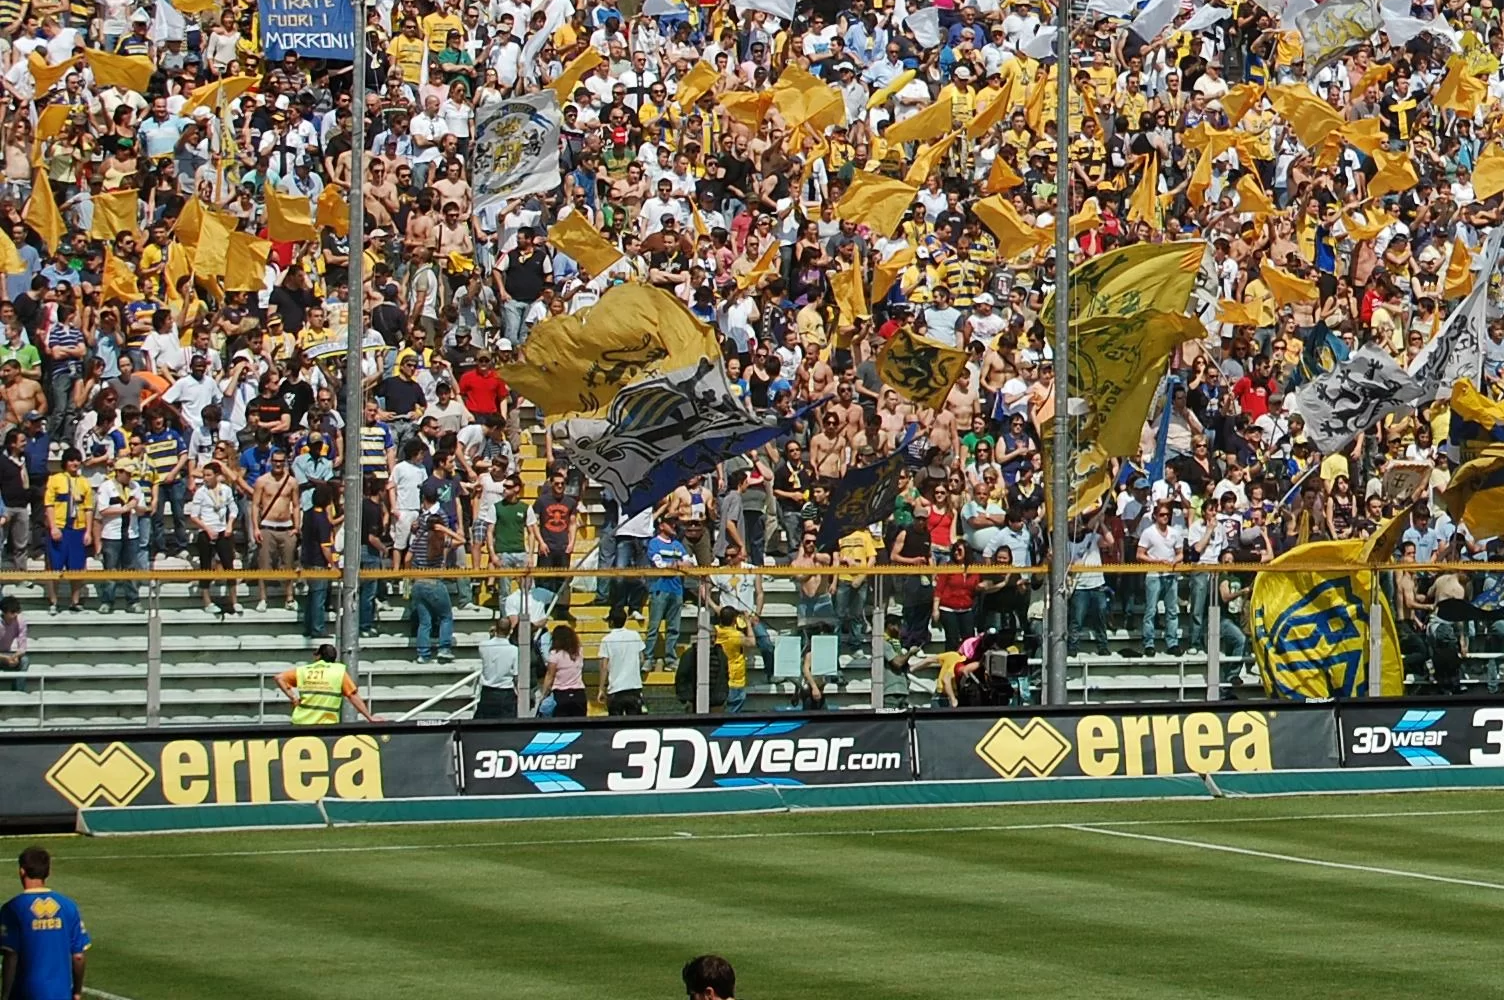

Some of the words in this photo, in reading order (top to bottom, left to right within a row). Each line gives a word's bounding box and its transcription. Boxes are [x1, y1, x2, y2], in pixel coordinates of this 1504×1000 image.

[268, 13, 313, 27] FUORI
[323, 13, 328, 26] I
[1076, 711, 1273, 776] errea
[1352, 726, 1448, 754] 3Dwear
[161, 734, 384, 804] errea
[474, 750, 583, 779] 3Dwear
